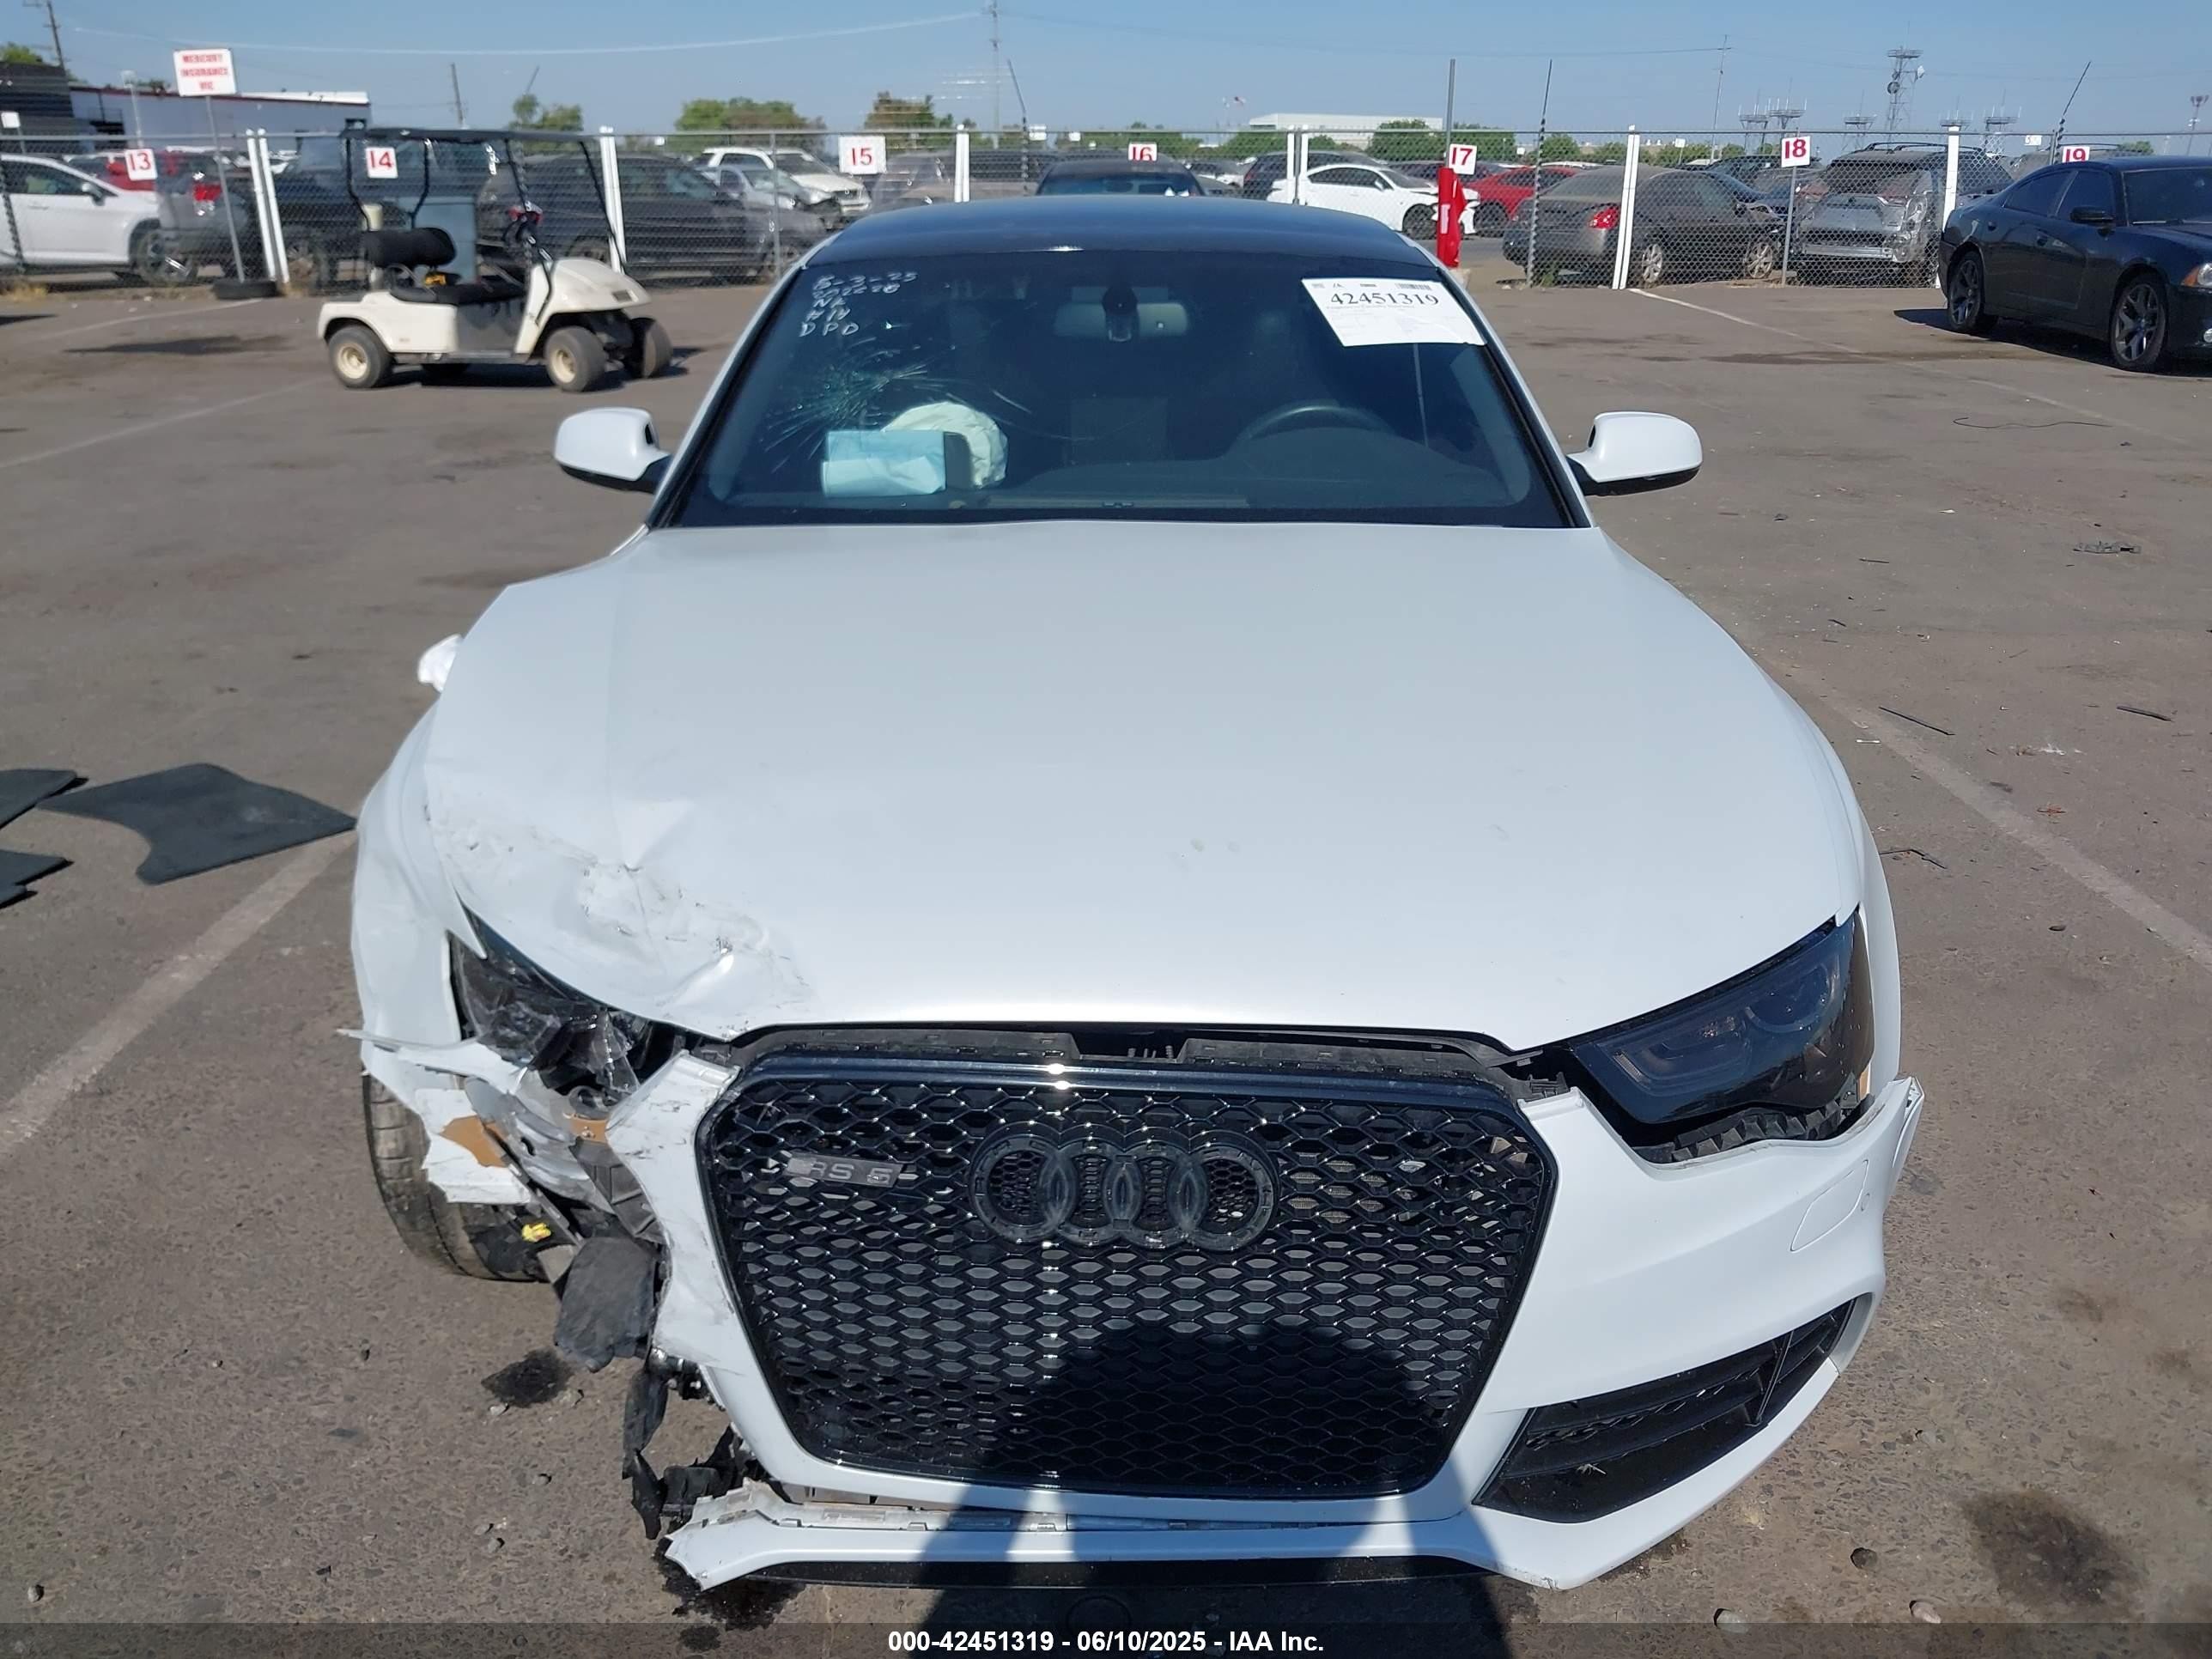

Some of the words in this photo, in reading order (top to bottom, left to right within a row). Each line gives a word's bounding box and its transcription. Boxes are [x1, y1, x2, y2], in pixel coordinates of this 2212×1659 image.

[853, 148, 872, 166] 15
[1133, 147, 1152, 161] 16
[1451, 147, 1473, 165] 17
[1784, 138, 1807, 159] 18
[2065, 148, 2087, 163] 19
[130, 152, 151, 171] 13
[370, 150, 392, 168] 14
[1331, 292, 1439, 305] 42451319
